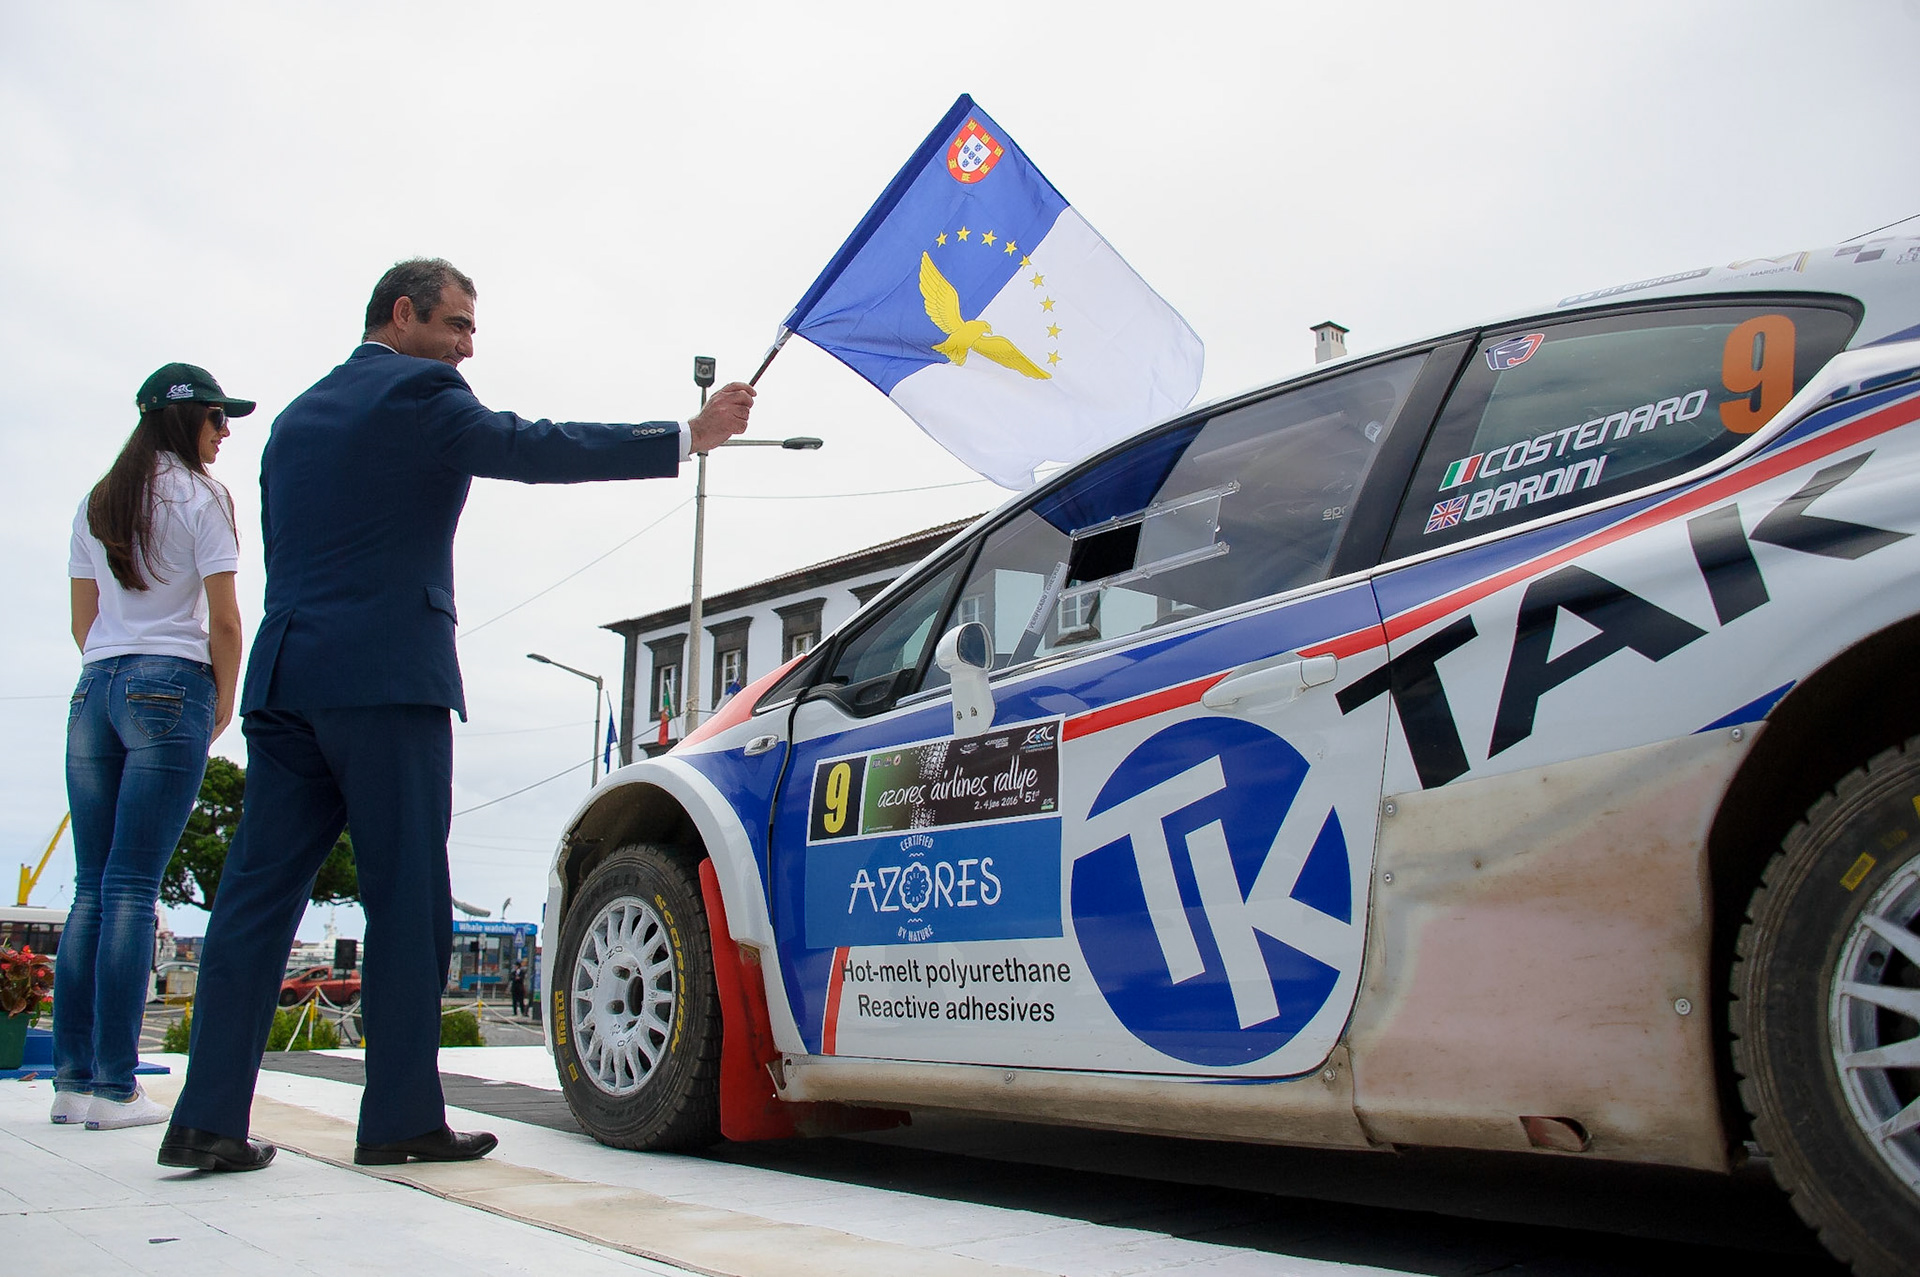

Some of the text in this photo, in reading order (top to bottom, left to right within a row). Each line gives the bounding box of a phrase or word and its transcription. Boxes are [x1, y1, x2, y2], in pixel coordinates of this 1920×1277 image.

[1622, 269, 1702, 293] Empresas
[1749, 265, 1793, 278] MARQUES
[1720, 315, 1796, 434] 9
[1479, 389, 1708, 479] COSTENARO
[1464, 454, 1608, 522] BARDINI
[1335, 450, 1914, 789] TAK
[1021, 725, 1055, 746] ERC
[824, 762, 851, 833] 9
[877, 754, 1039, 808] azores airlines rallye
[1001, 796, 1019, 808] 2016
[900, 834, 935, 852] CERTIFIED
[847, 856, 1003, 915] AZORES
[1072, 754, 1352, 1030] TK
[484, 924, 516, 935] watchin
[897, 923, 935, 943] BY NATURE
[654, 893, 686, 1053] SCORPION
[841, 957, 1072, 988] Hot-melt polyurethane
[857, 993, 1056, 1023] Reactive adhesives
